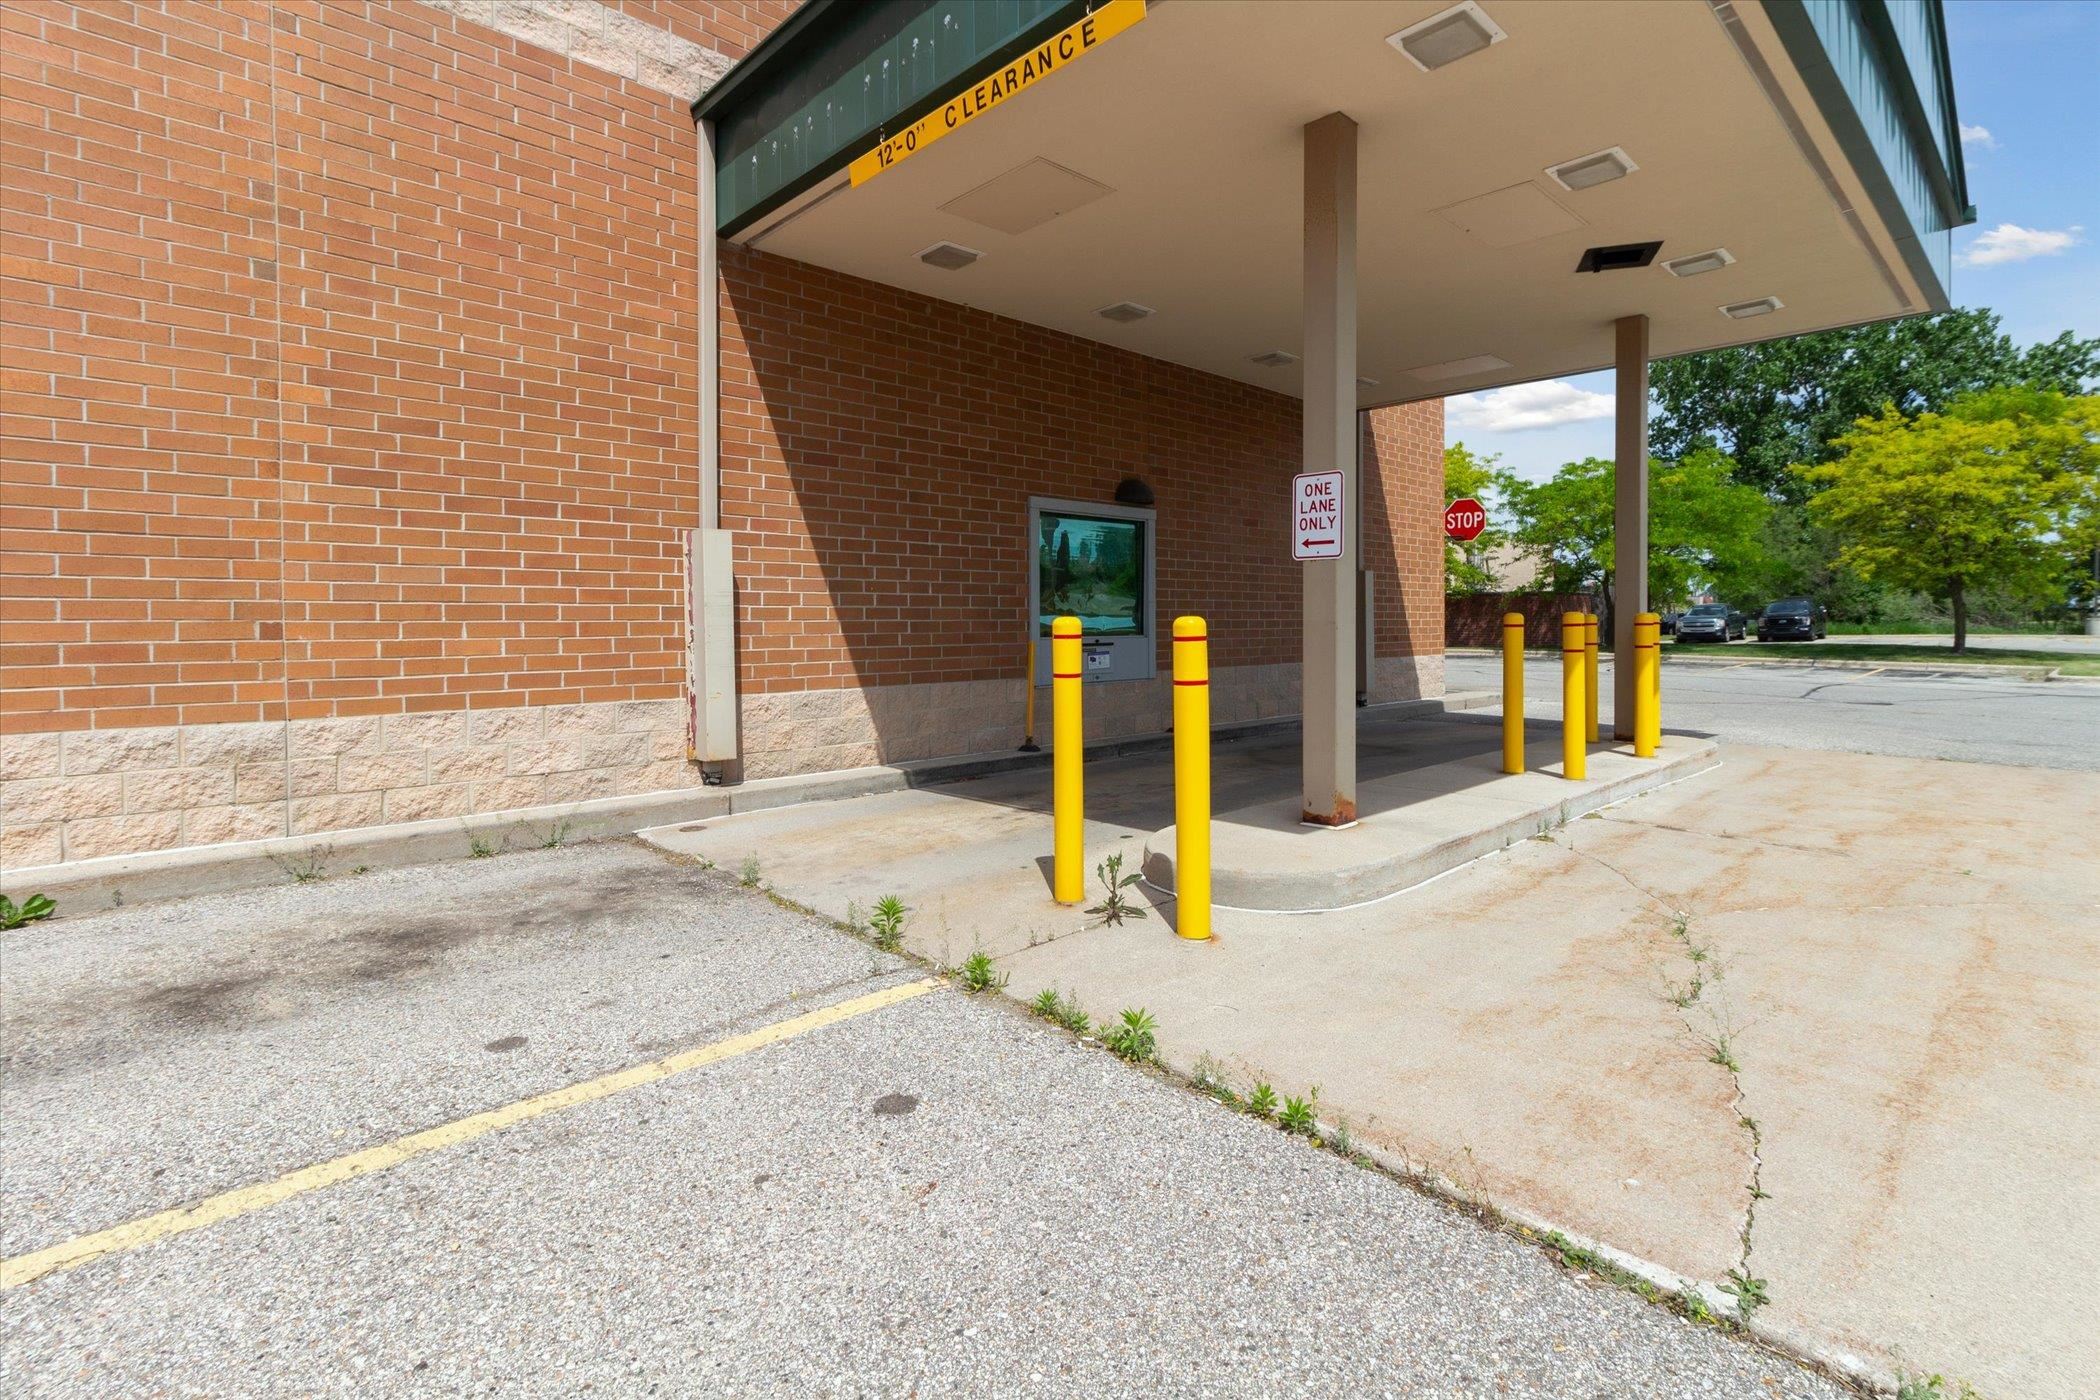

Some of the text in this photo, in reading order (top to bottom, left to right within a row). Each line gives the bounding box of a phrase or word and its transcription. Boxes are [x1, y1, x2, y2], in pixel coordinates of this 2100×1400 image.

[944, 19, 1097, 128] CLEARANCE
[1305, 482, 1332, 497] ONE
[1300, 498, 1336, 514] LANE
[1299, 515, 1336, 531] ONLY
[1446, 511, 1483, 529] STOP
